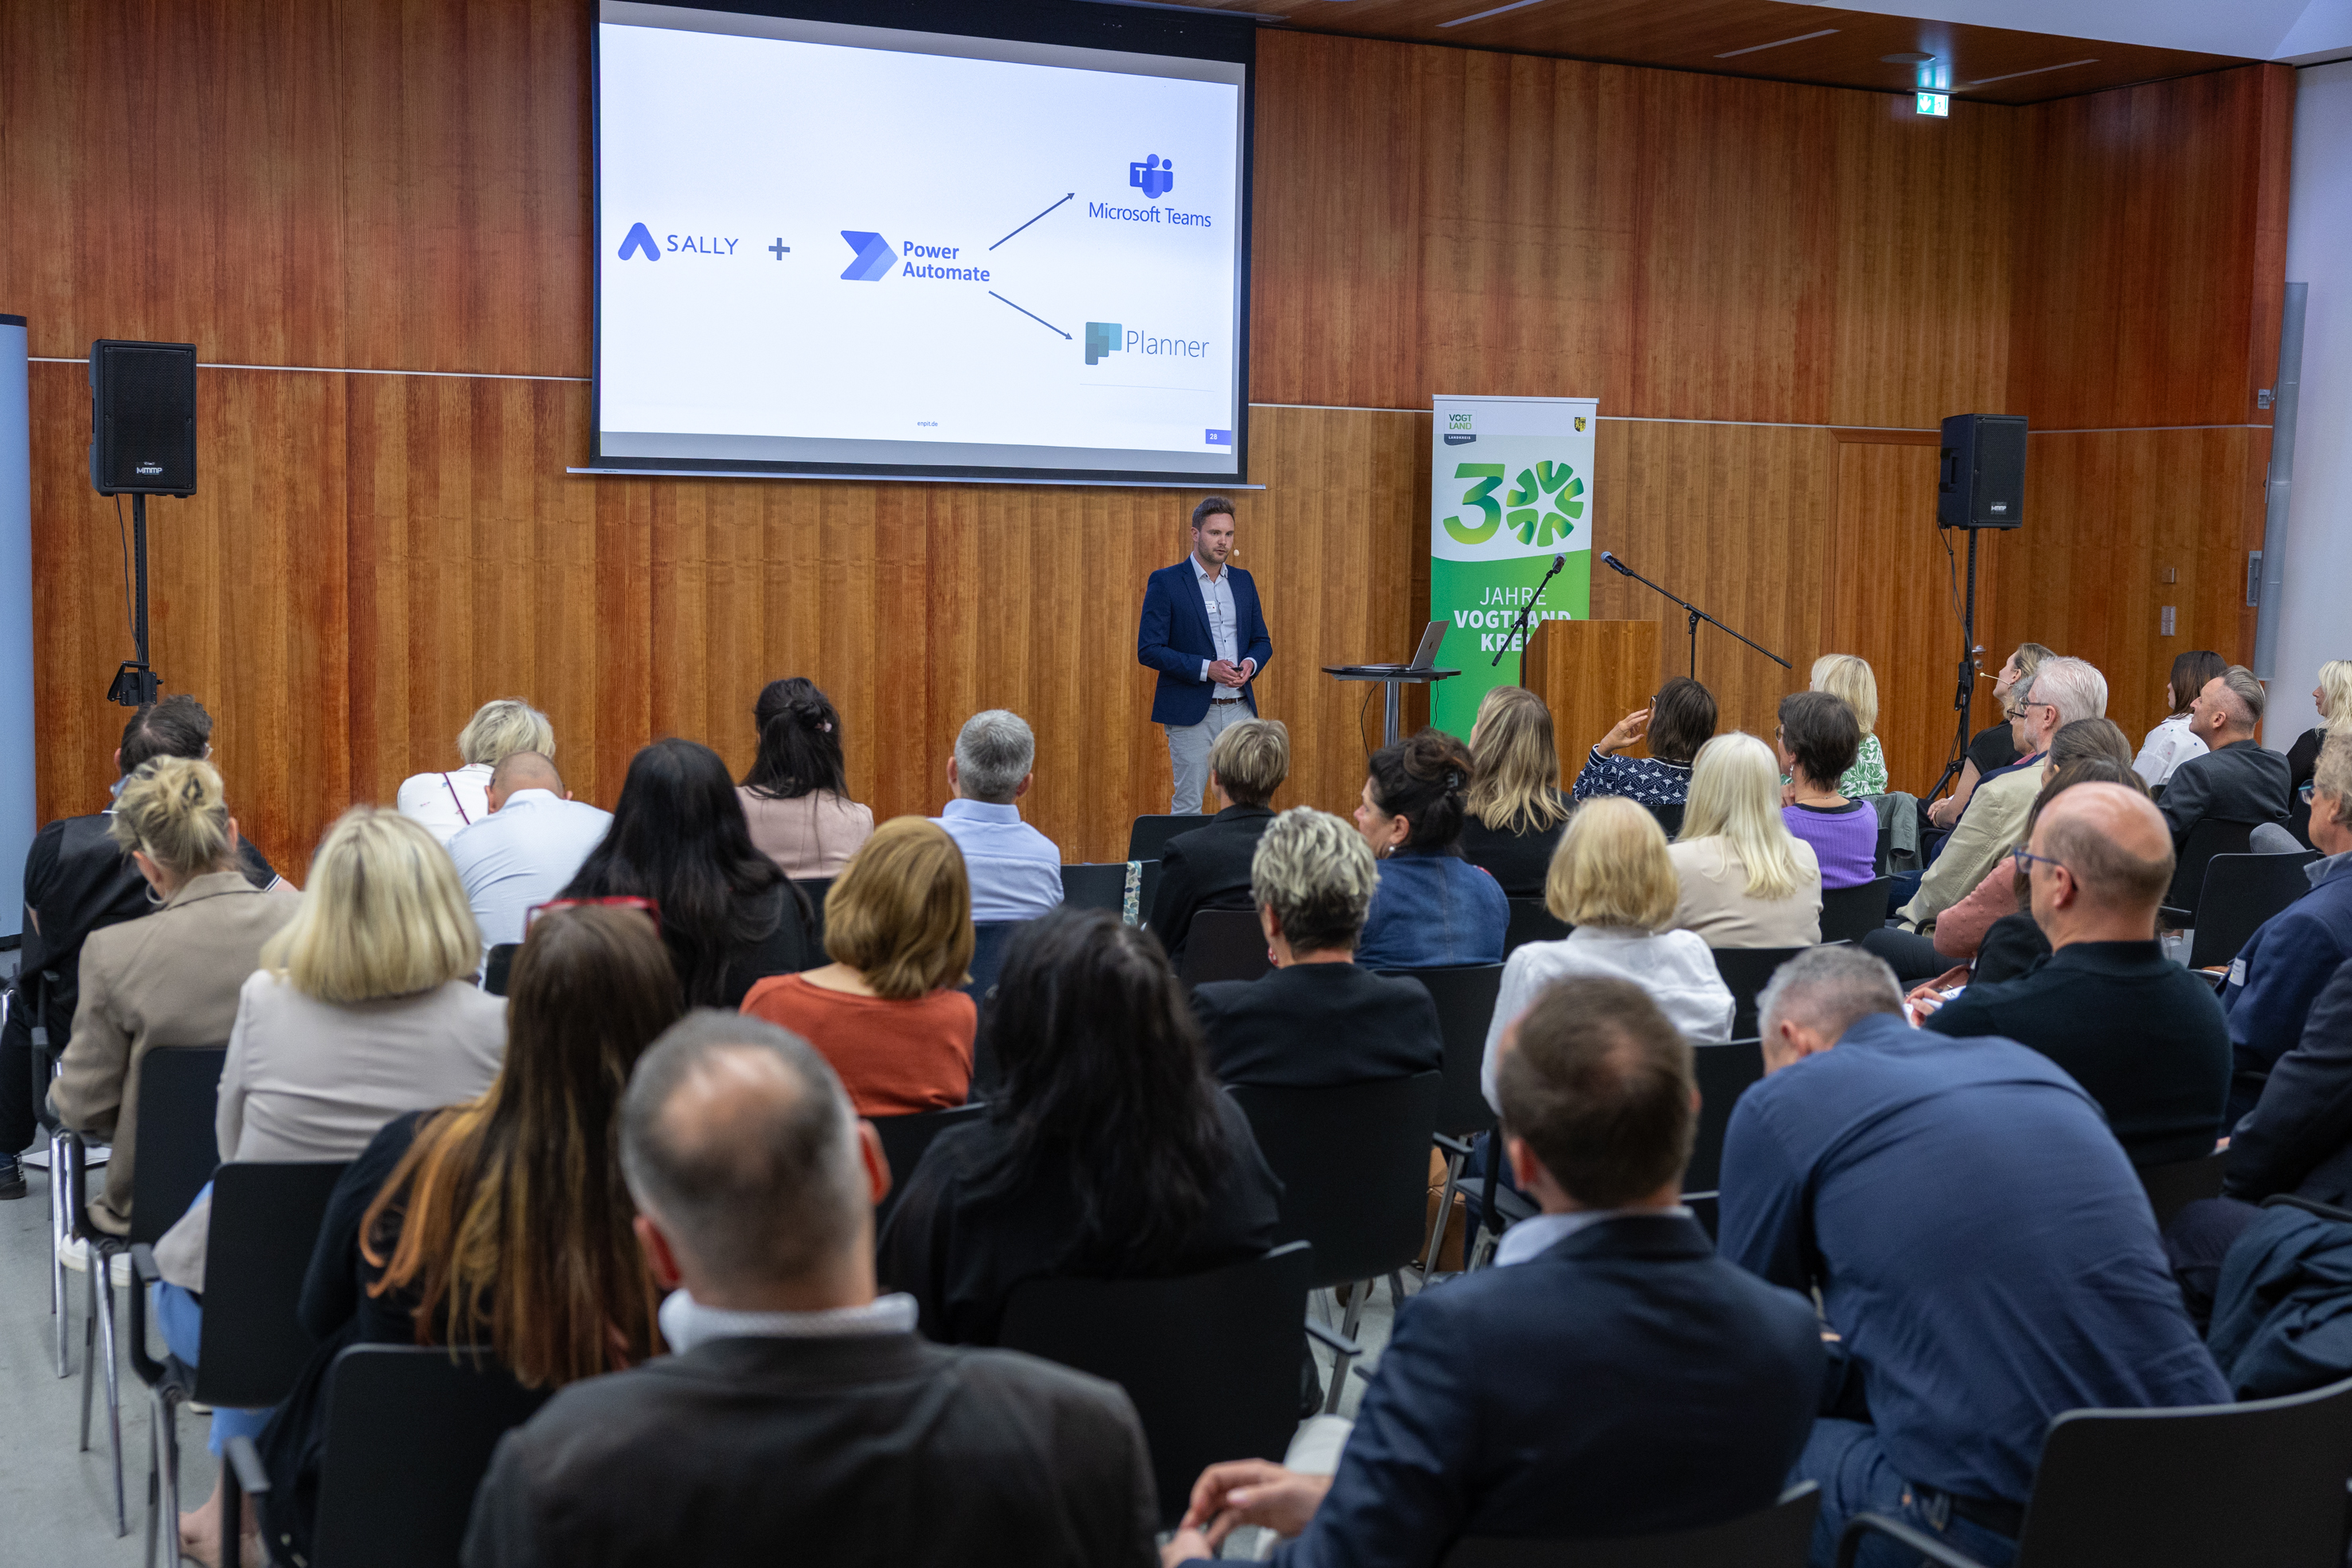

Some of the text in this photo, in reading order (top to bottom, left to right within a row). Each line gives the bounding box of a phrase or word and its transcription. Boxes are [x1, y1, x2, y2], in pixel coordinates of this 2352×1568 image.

[1089, 201, 1211, 228] Microsoft Teams
[667, 234, 739, 255] SALLY
[903, 240, 960, 260] Power
[902, 261, 991, 282] Automate
[1126, 330, 1210, 358] Planner
[1449, 413, 1473, 422] VOGT
[1479, 587, 1547, 605] JAHRE
